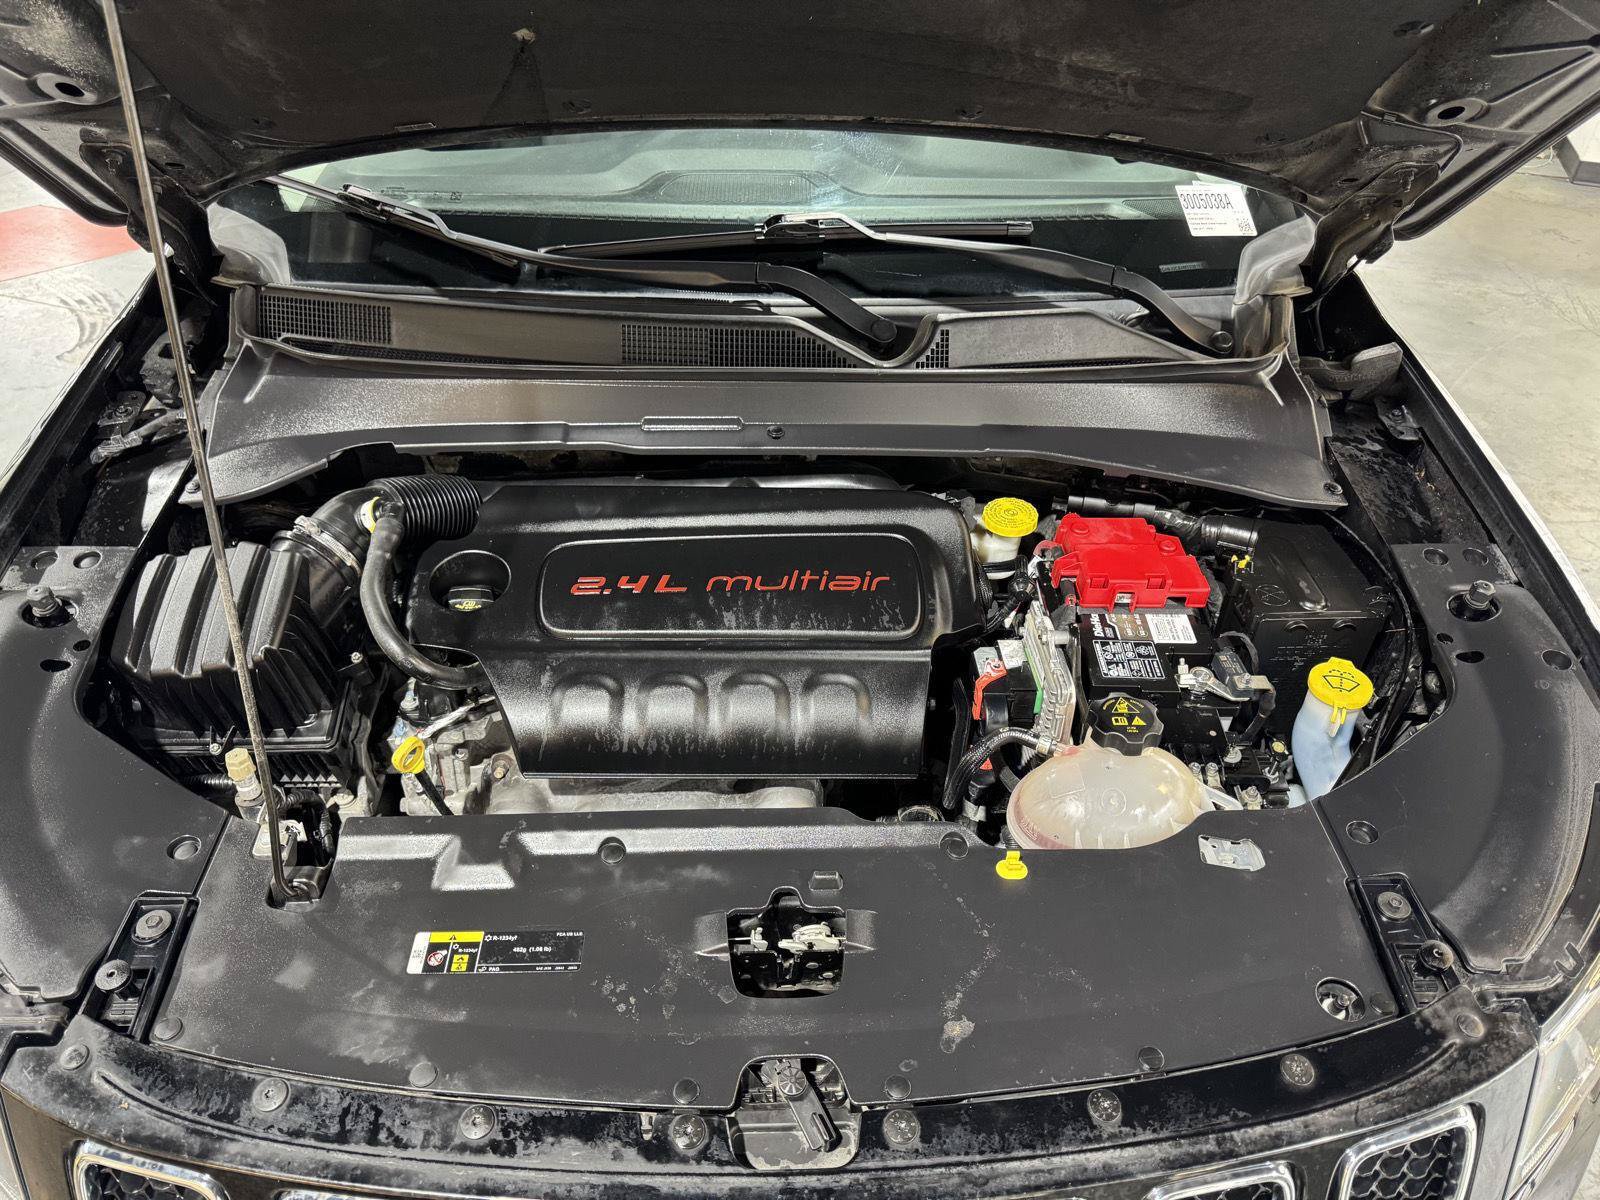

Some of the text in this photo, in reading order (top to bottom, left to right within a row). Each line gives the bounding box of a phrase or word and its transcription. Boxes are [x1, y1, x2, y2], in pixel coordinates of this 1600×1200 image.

[1180, 193, 1234, 210] 3005038A
[706, 569, 891, 592] multiair
[492, 934, 518, 942] R-1234yf
